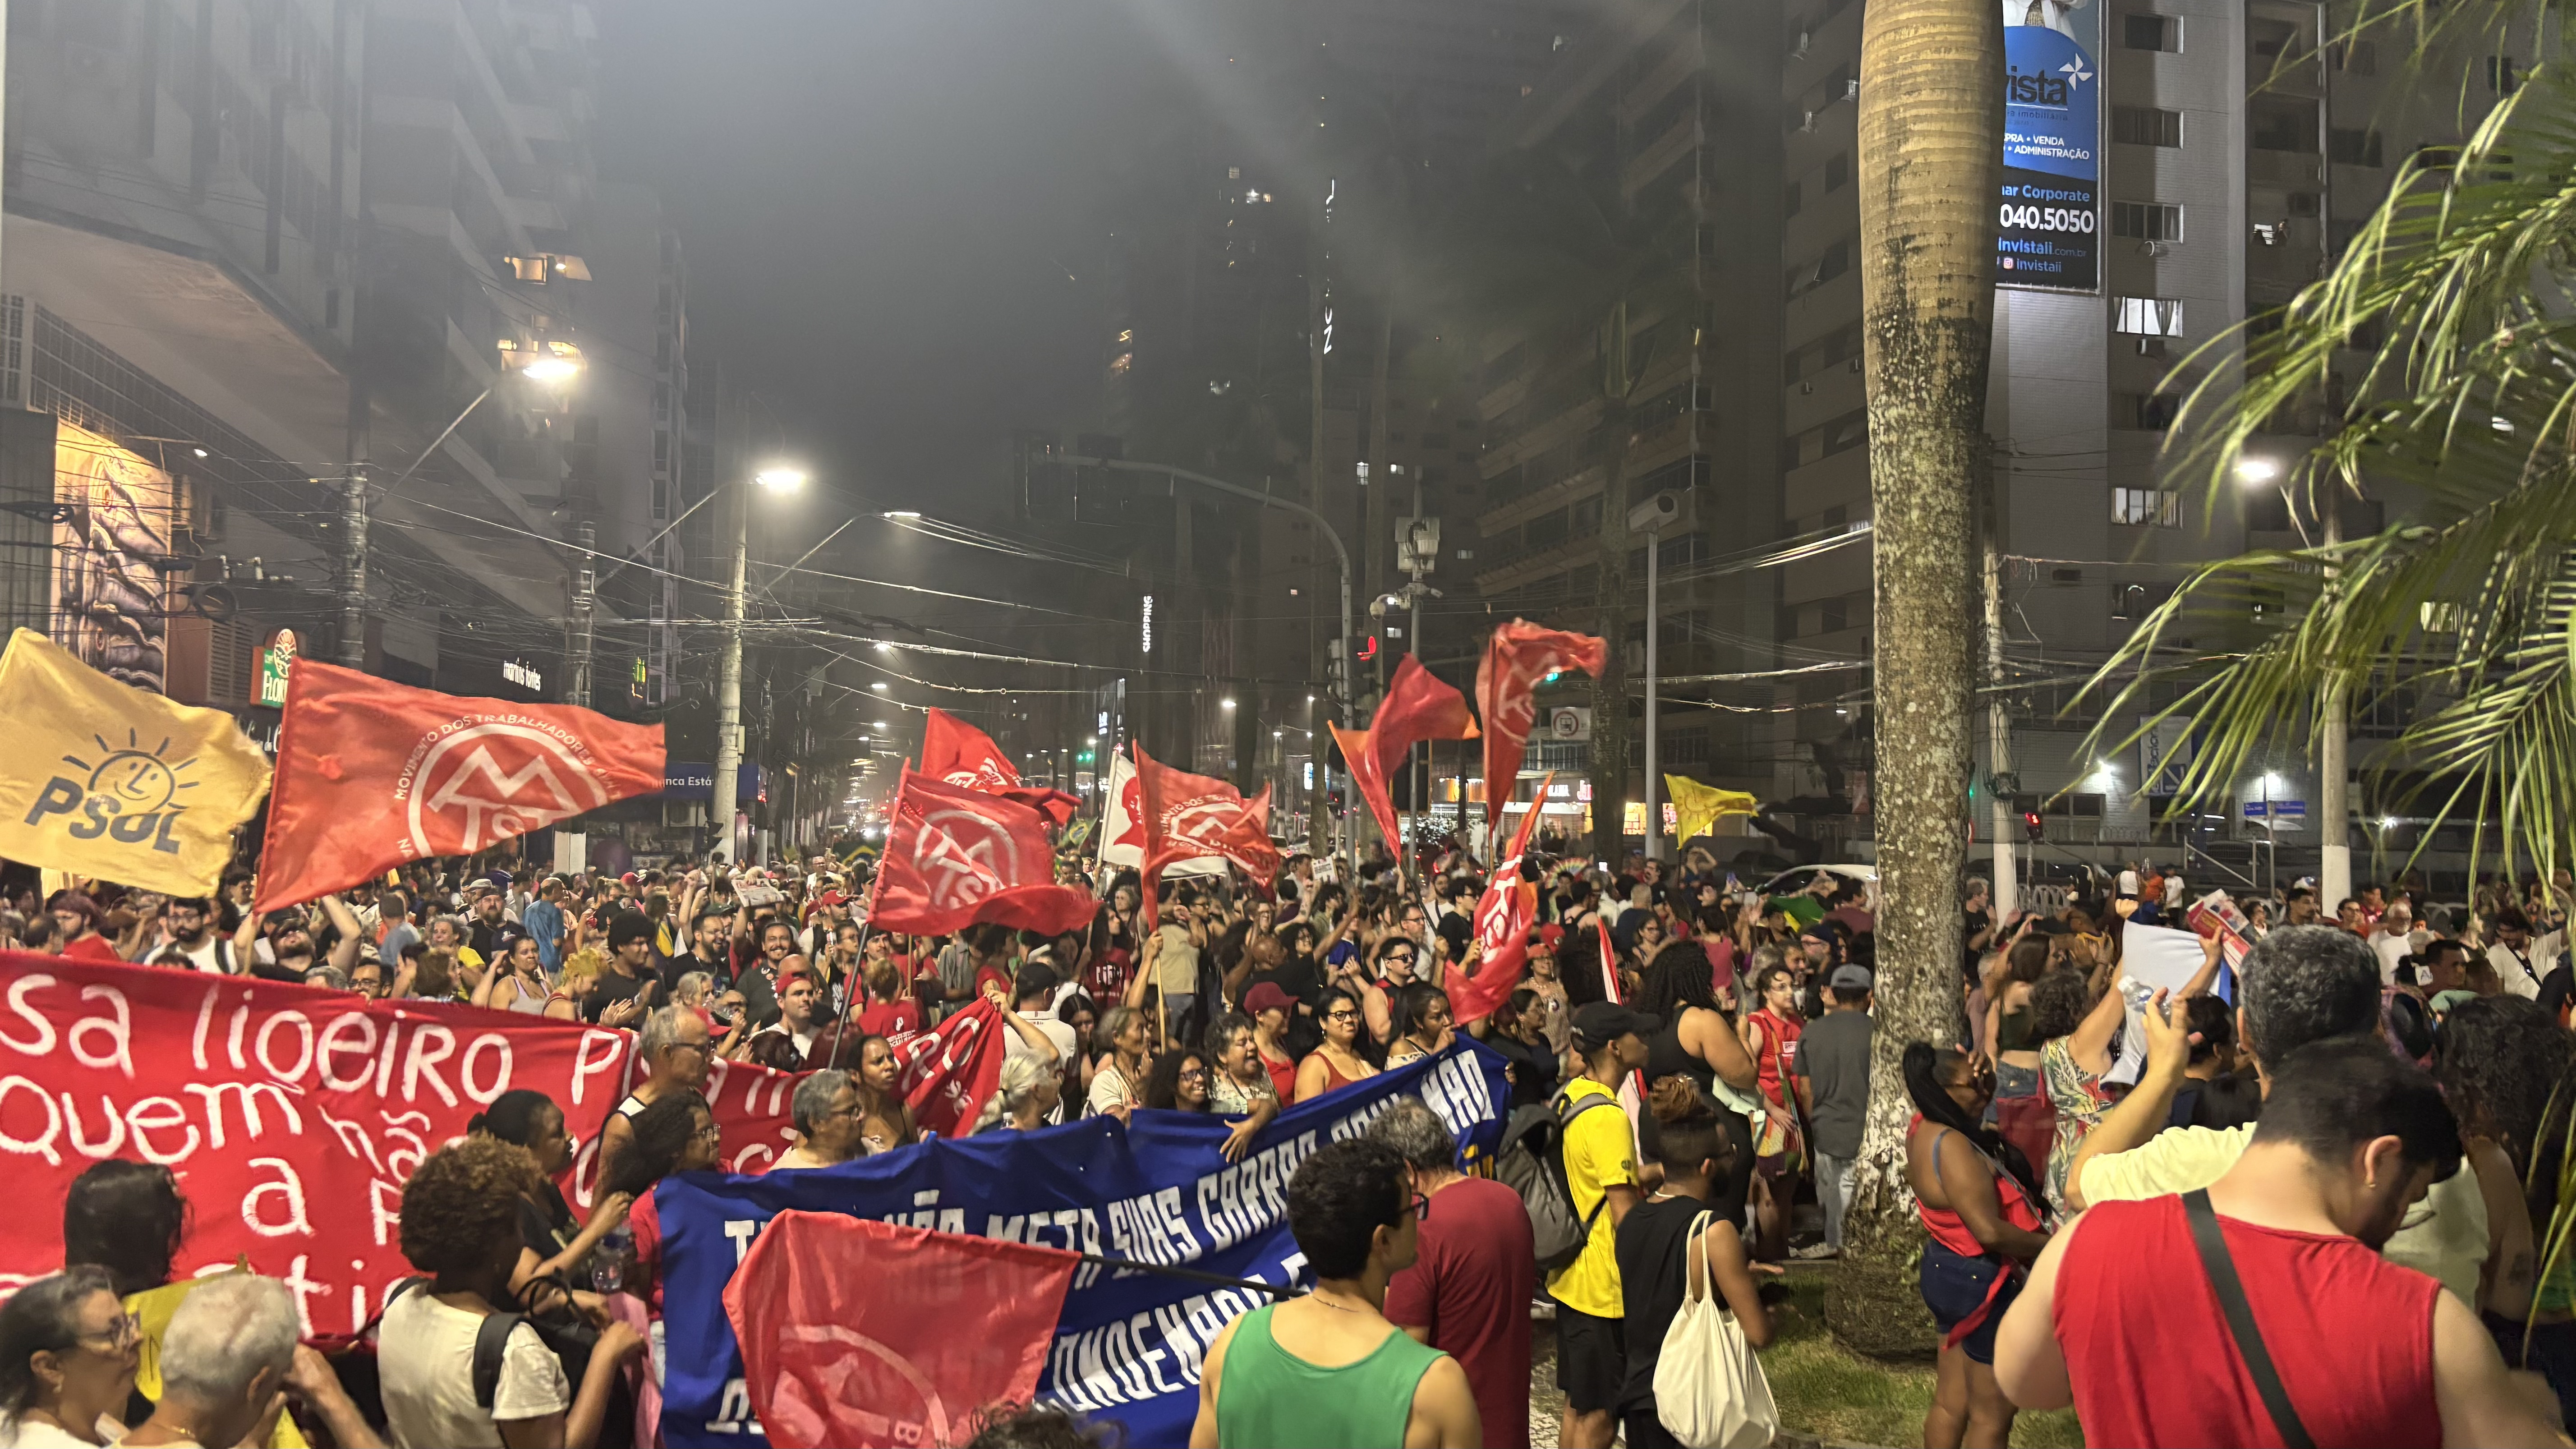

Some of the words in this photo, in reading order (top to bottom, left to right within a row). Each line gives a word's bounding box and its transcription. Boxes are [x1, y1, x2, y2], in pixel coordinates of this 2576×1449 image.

[2033, 134, 2065, 146] VENDA
[2014, 145, 2090, 160] ADMINISTRAÇÃO
[2022, 185, 2090, 202] Corporate
[2000, 203, 2094, 234] 040.5050
[1142, 595, 1153, 653] SHOPPING
